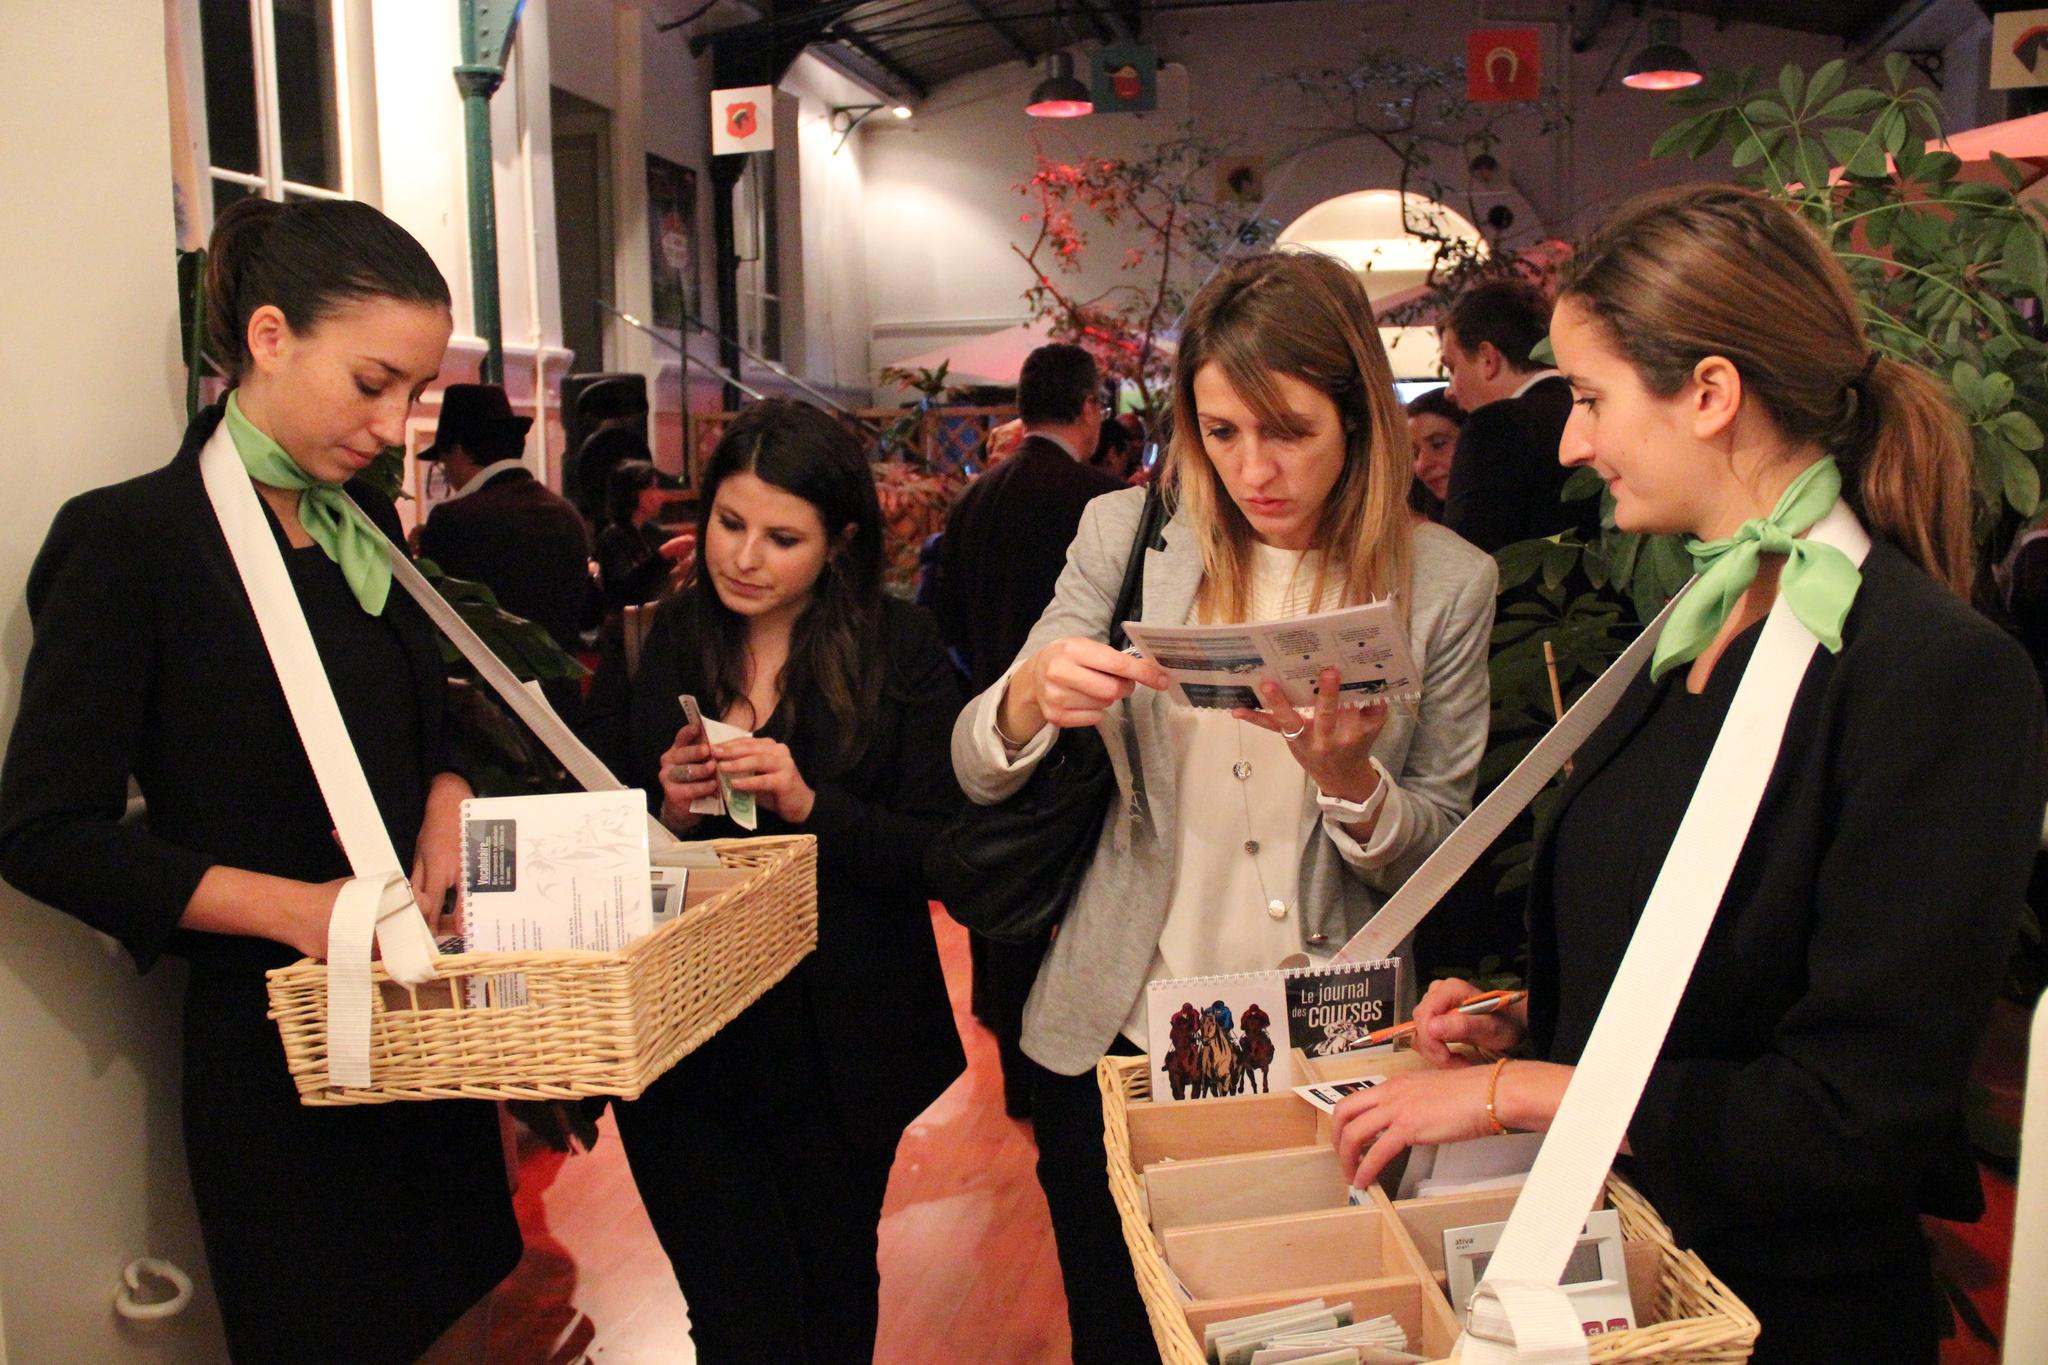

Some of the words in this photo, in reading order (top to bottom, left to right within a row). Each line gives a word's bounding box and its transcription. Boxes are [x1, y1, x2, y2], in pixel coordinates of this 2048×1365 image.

[1301, 989, 1314, 1004] Le
[1317, 978, 1369, 1006] journal
[1292, 1007, 1307, 1018] des
[1308, 1000, 1383, 1028] courses
